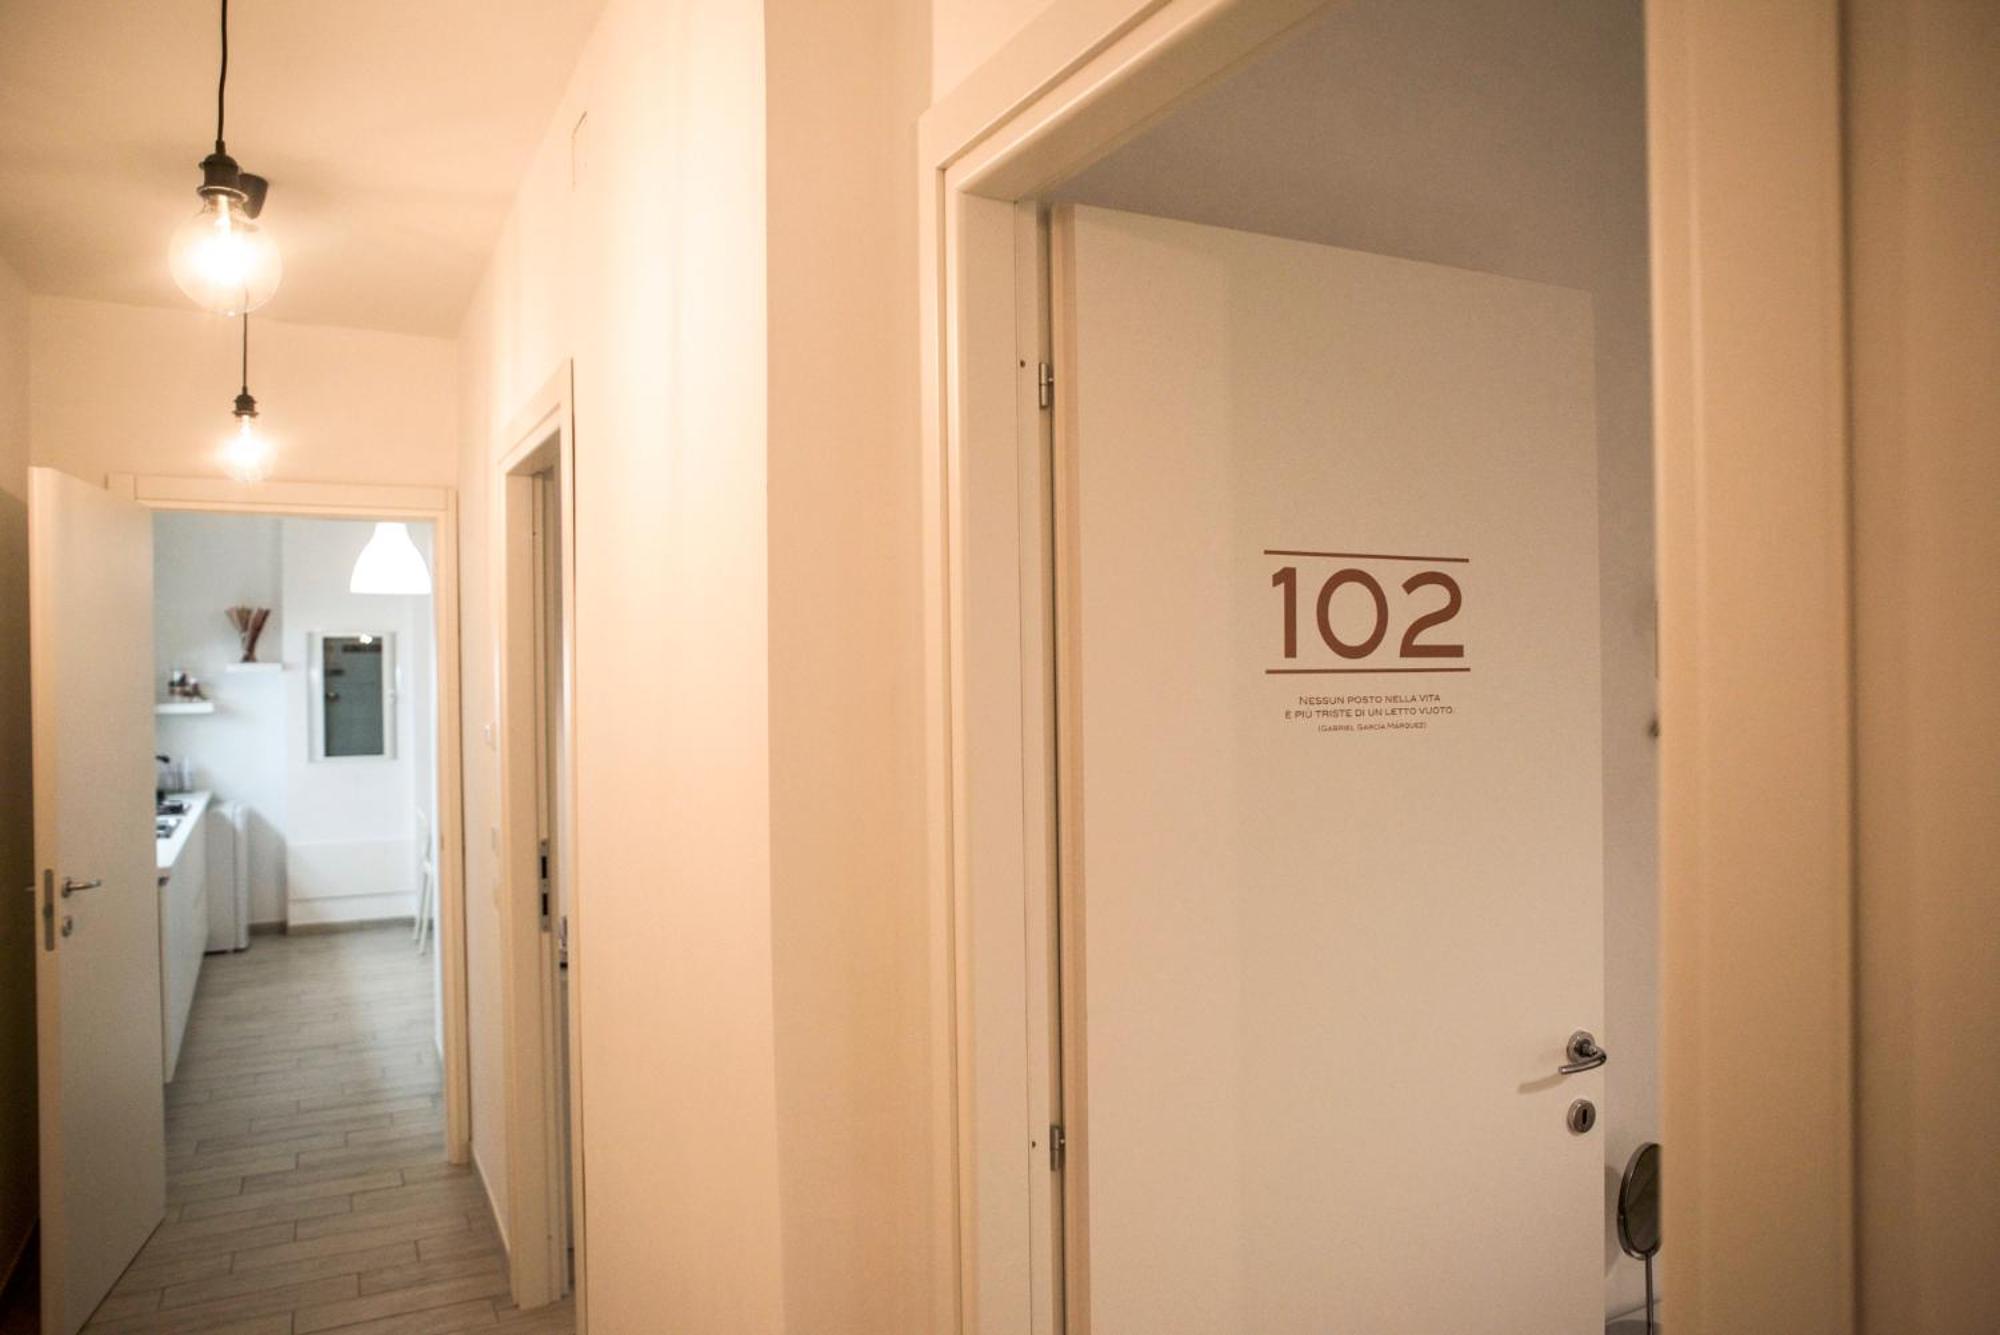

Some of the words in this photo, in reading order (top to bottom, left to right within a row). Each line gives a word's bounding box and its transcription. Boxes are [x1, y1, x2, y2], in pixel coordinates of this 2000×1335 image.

[1272, 566, 1465, 659] 102
[1299, 695, 1345, 705] NESSUN
[1347, 695, 1383, 704] POSTO
[1385, 694, 1417, 703] NELLA
[1419, 693, 1441, 702] VITA
[1314, 708, 1353, 718] TRISTE
[1355, 708, 1365, 717] DI
[1367, 707, 1383, 717] UN
[1385, 707, 1417, 716] LETTO
